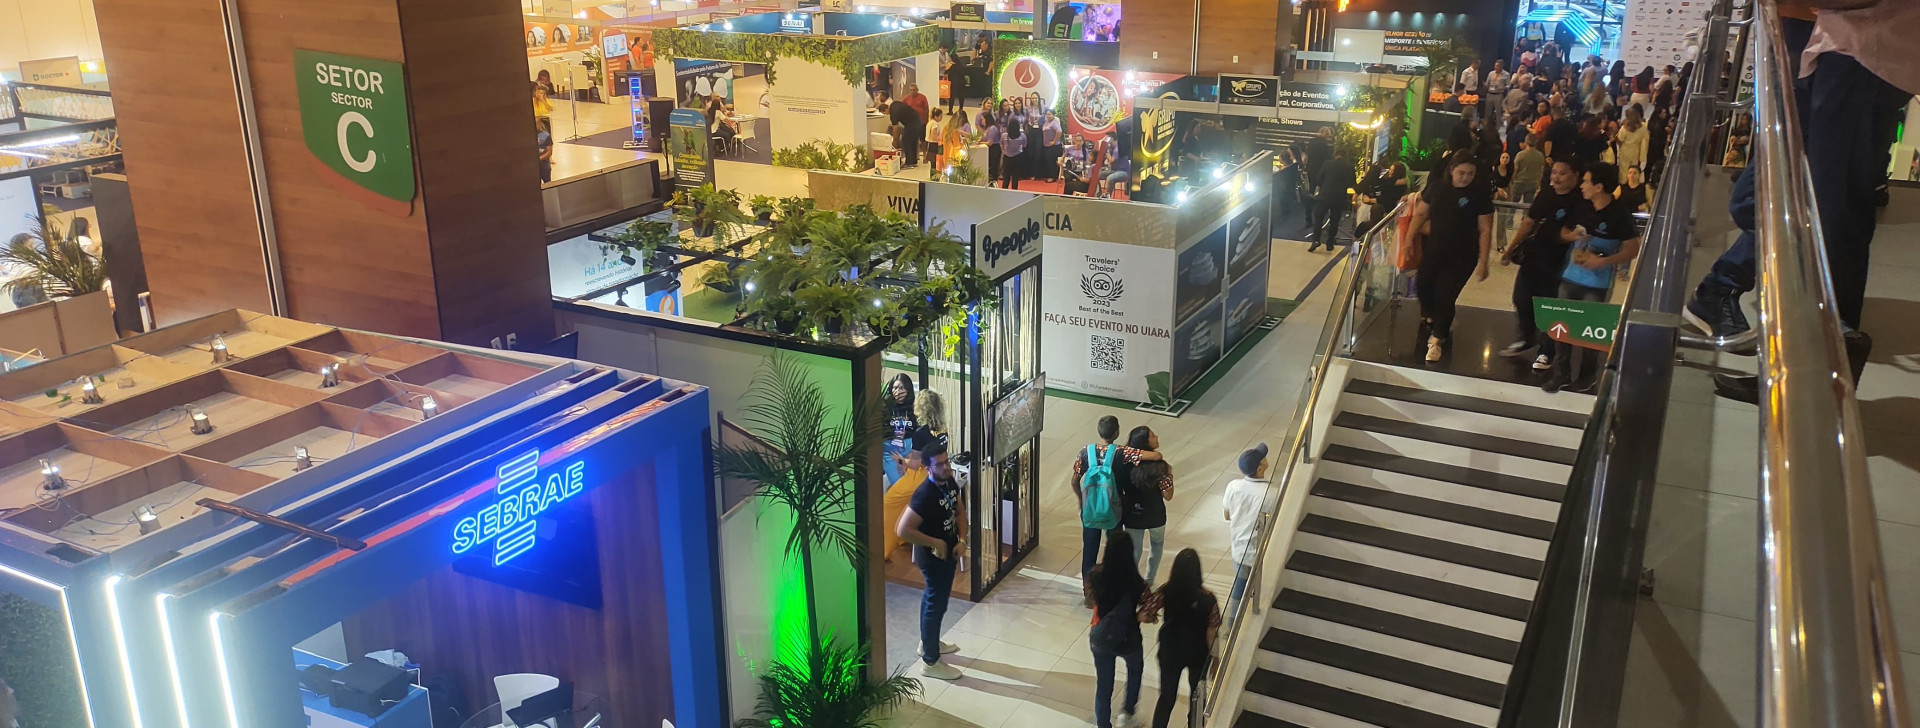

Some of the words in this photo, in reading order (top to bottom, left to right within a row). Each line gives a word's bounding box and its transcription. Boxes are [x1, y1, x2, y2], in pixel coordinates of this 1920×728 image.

[315, 62, 384, 94] SETOR
[331, 92, 373, 110] SECTOR
[1302, 91, 1330, 100] Eventos
[1291, 100, 1336, 110] Corporativos,
[1258, 116, 1280, 125] Feiras,
[1281, 117, 1303, 126] Shows
[337, 111, 377, 173] C
[1085, 255, 1120, 266] Travelers'
[1088, 263, 1116, 273] Choice
[1092, 299, 1111, 308] 2023
[1110, 309, 1124, 317] Best
[1044, 312, 1067, 326] FAÇA
[1069, 315, 1086, 327] SEU
[1088, 318, 1123, 332] EVENTO
[1125, 323, 1139, 335] NO
[1141, 326, 1171, 340] UIARA
[1581, 325, 1607, 340] AO
[452, 461, 585, 554] SEBRAE
